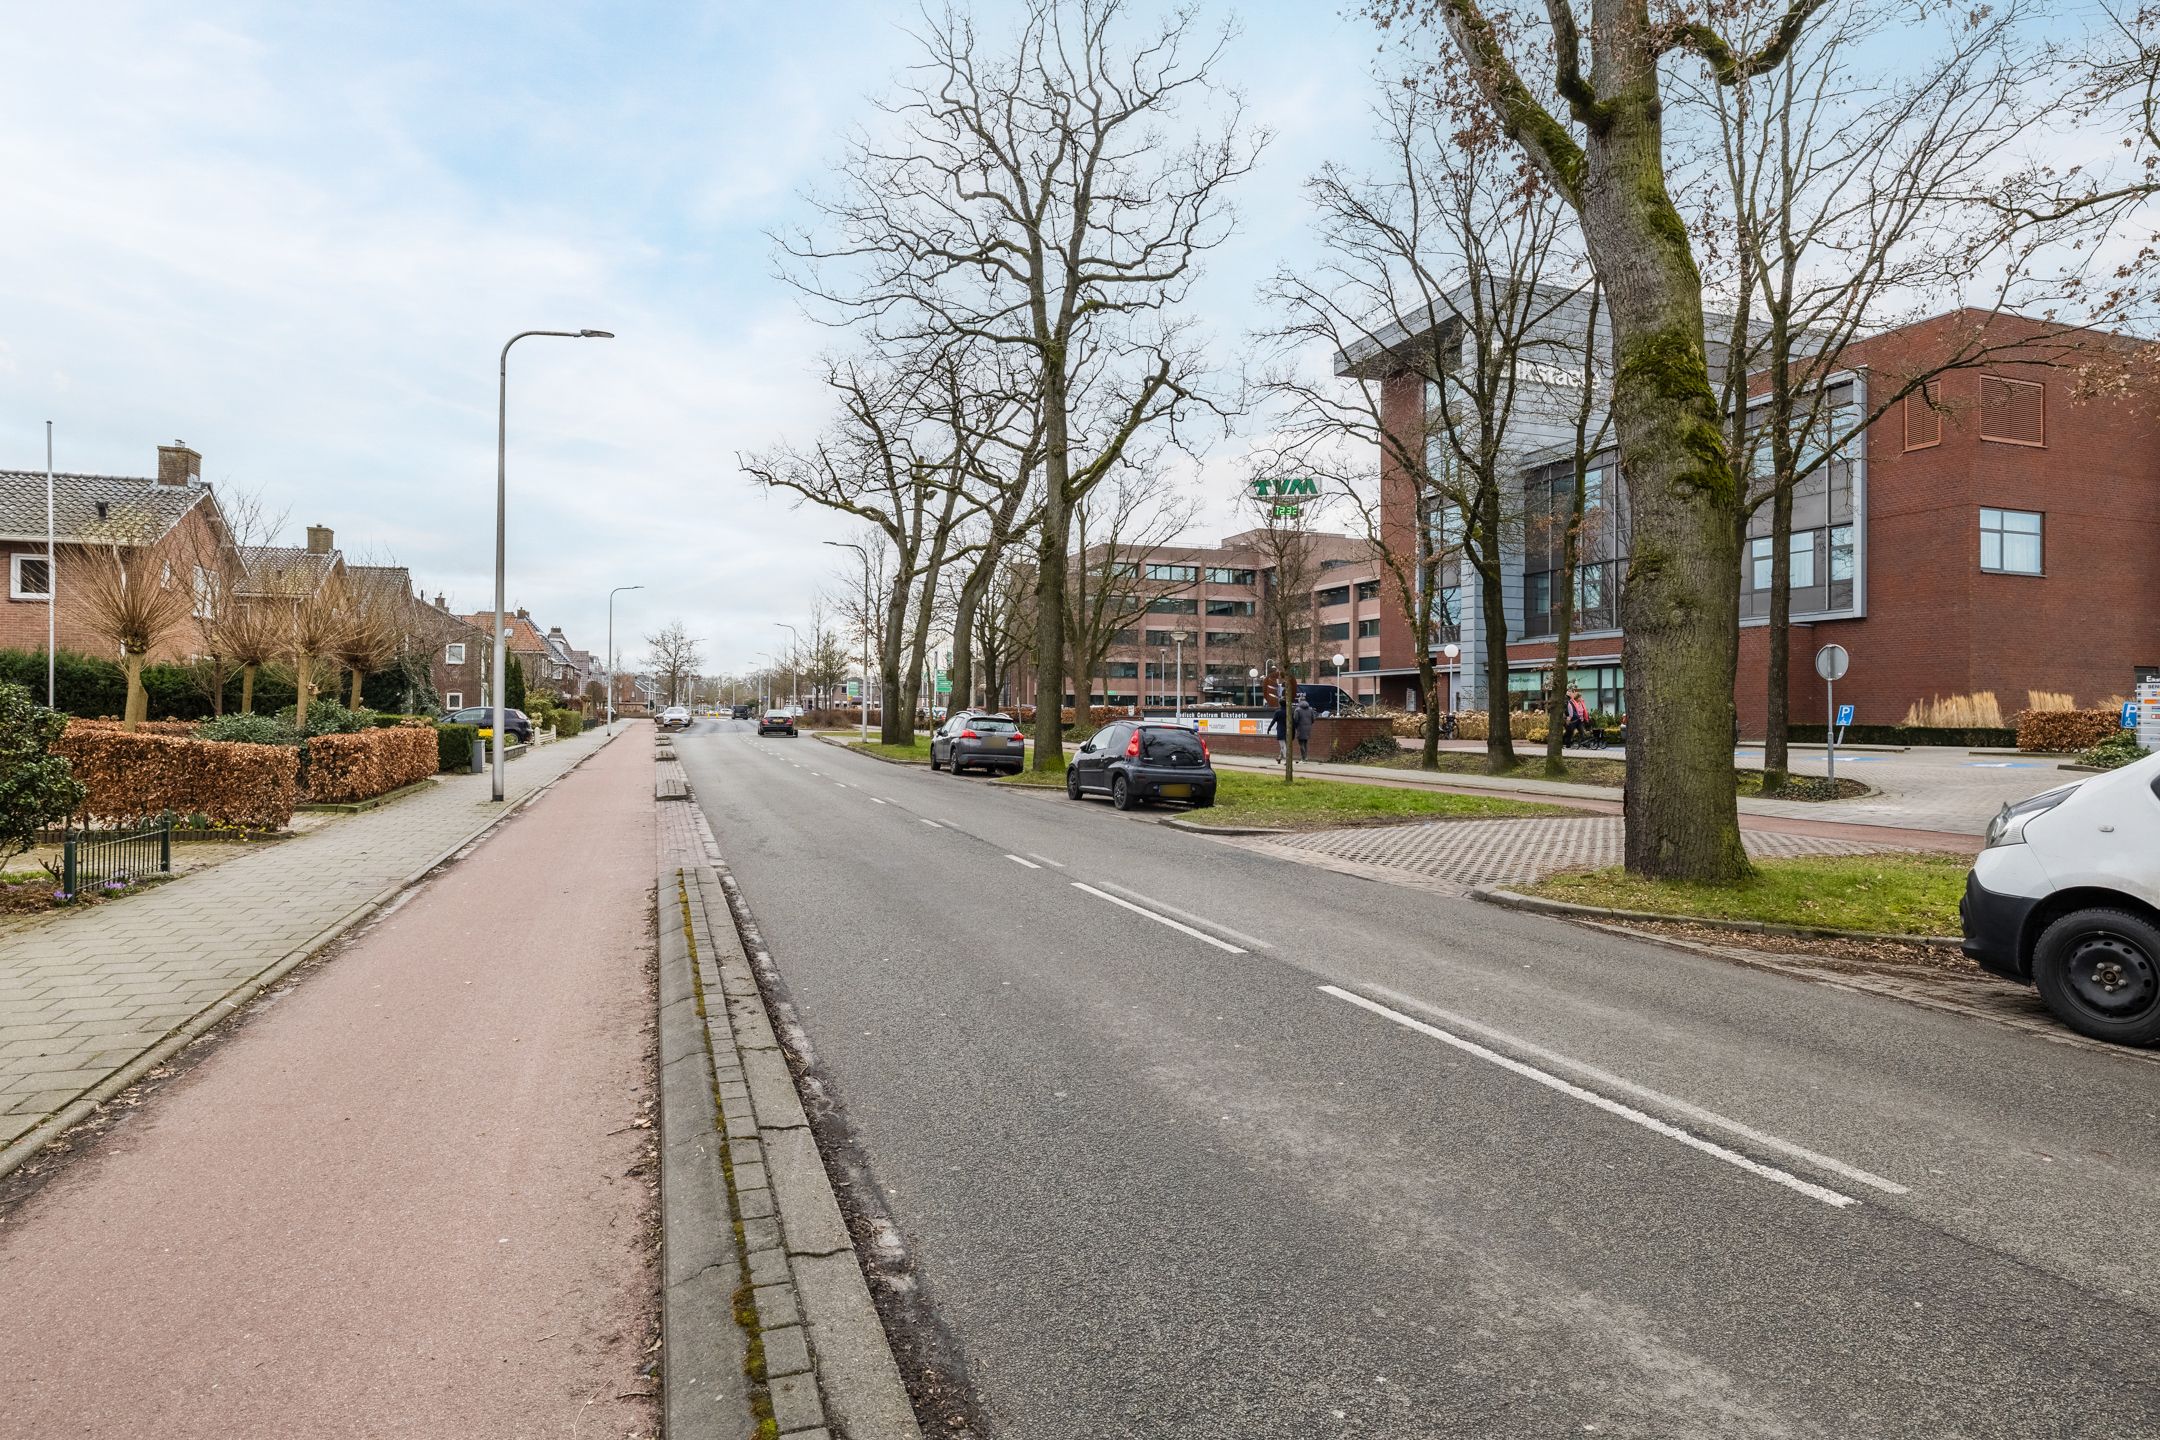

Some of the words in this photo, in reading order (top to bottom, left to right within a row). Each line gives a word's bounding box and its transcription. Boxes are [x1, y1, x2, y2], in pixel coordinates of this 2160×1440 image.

[1253, 479, 1318, 495] TVM
[1841, 707, 1851, 718] P
[2126, 704, 2137, 717] P
